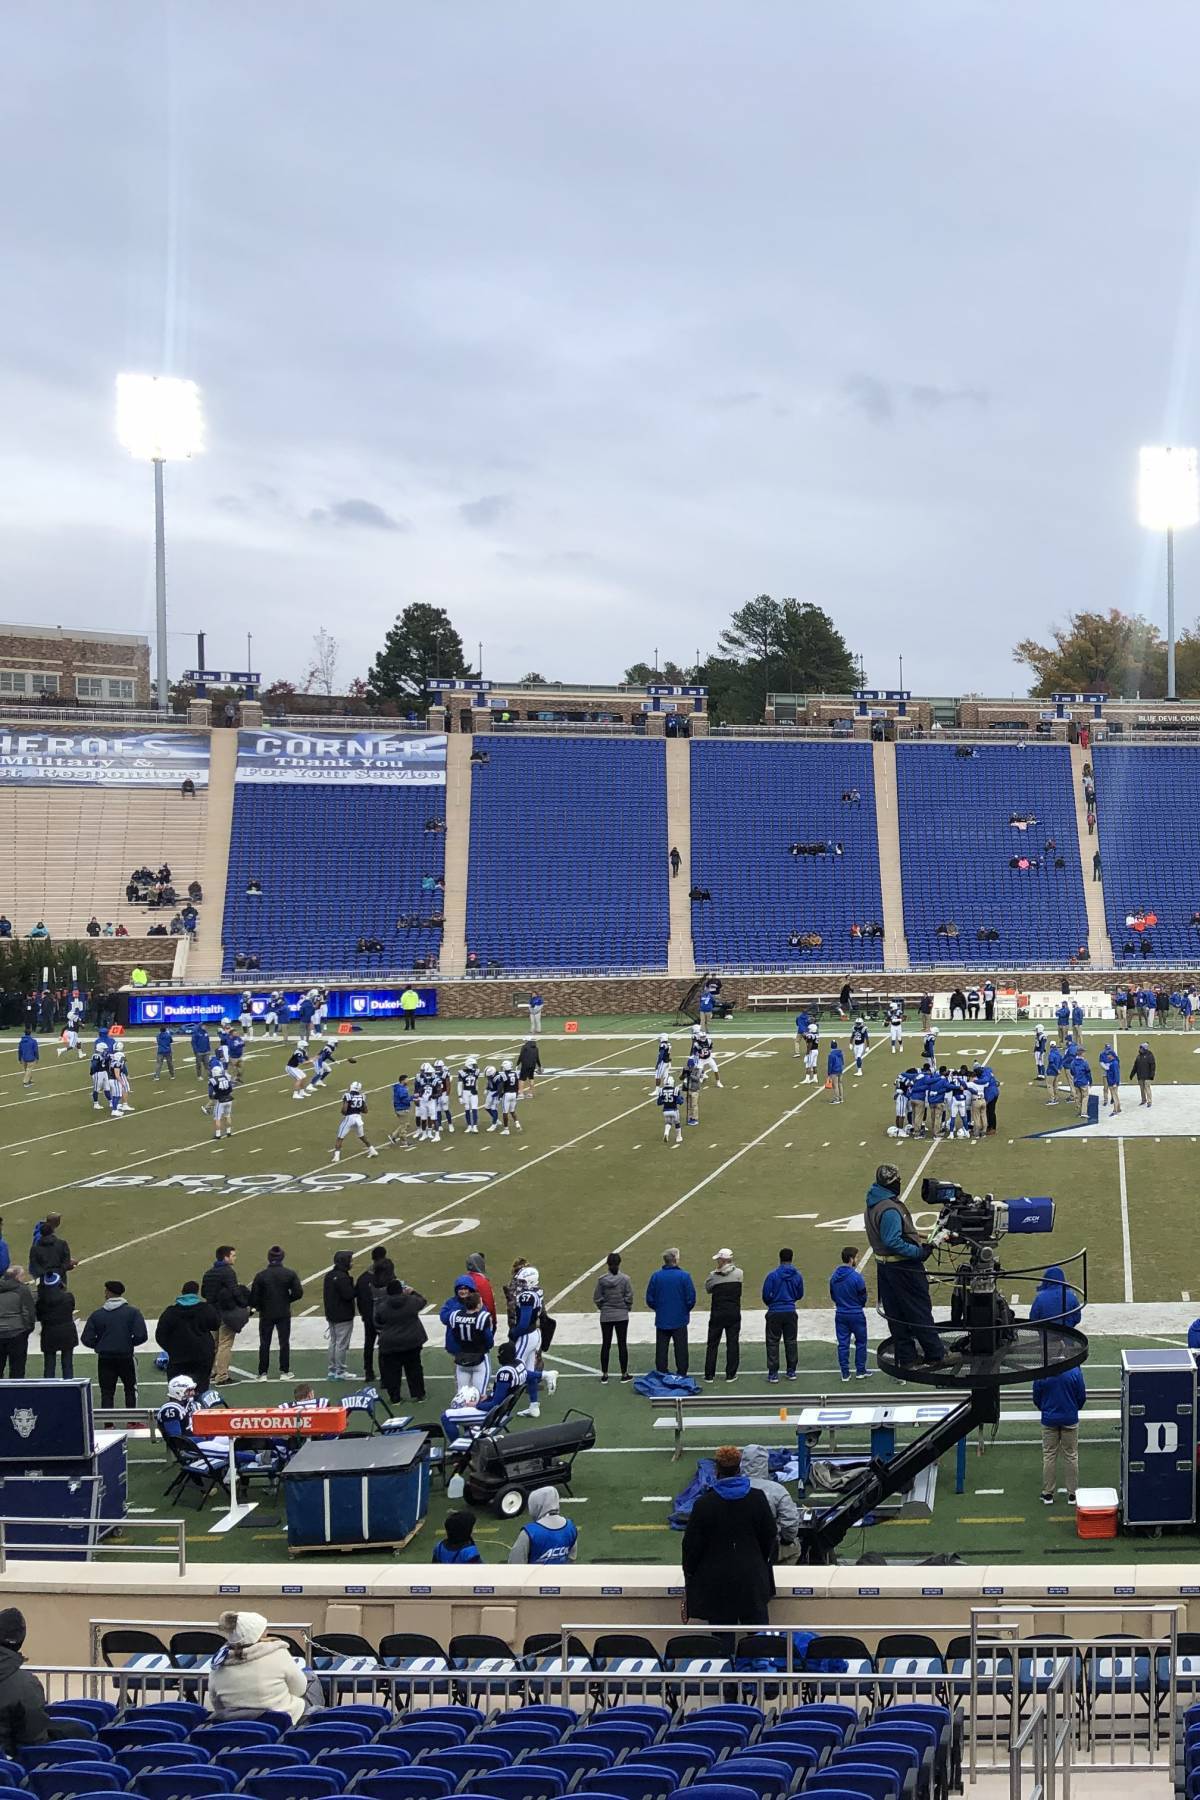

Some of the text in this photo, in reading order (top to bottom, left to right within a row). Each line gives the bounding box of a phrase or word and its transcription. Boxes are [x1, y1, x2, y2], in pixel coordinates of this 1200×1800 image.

[256, 737, 428, 758] CORNER
[0, 756, 154, 769] Military &
[274, 757, 404, 769] Thank You
[37, 768, 201, 781] Responders
[243, 767, 441, 780] For Your Service
[164, 1004, 225, 1016] DukeHealth
[370, 1000, 426, 1010] DukeHth
[350, 1097, 363, 1109] 33
[78, 1172, 500, 1188] BROOKS
[186, 1186, 345, 1195] FIELD
[324, 1217, 481, 1239] 30
[459, 1323, 473, 1342] 11
[342, 1395, 371, 1409] DUKE
[165, 1408, 175, 1419] 45
[229, 1416, 313, 1430] GATORADE
